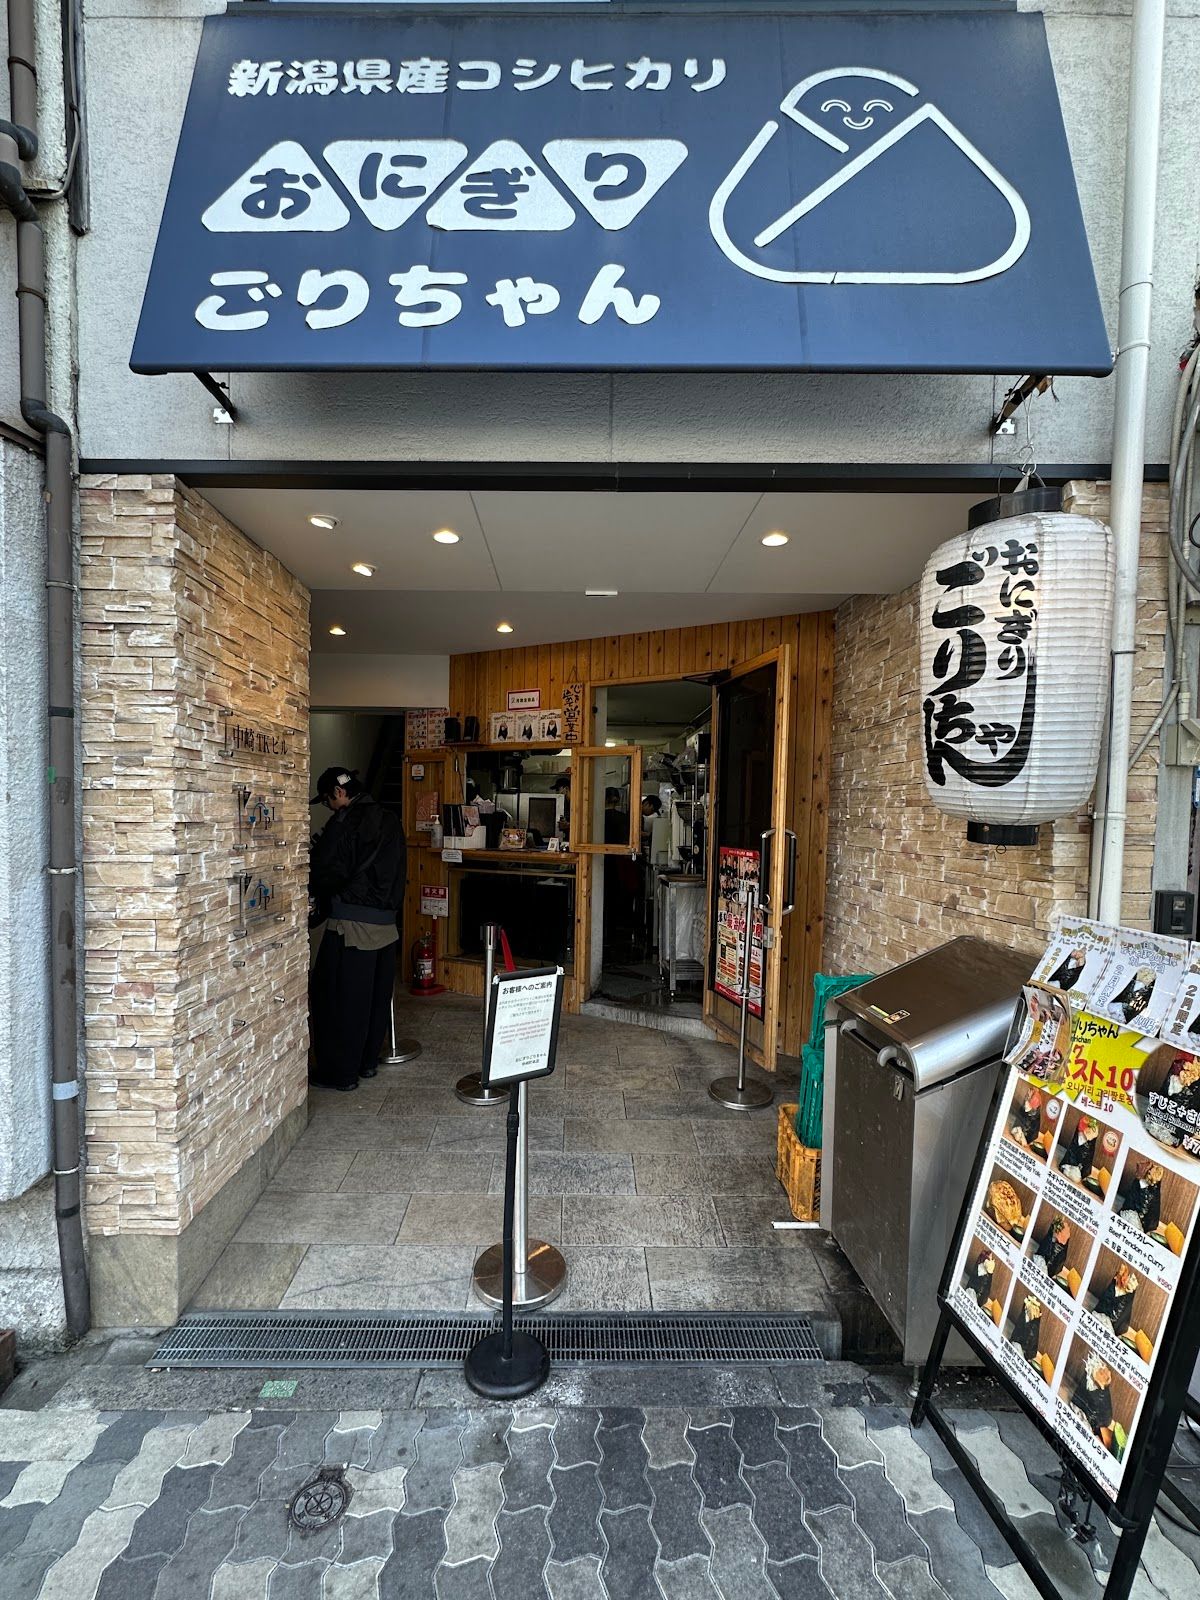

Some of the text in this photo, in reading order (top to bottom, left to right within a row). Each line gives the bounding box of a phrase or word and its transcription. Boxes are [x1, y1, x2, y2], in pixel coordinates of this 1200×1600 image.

[228, 56, 727, 97] 新潟県産コシヒカリ
[240, 149, 650, 223] おにぎり
[194, 263, 661, 332] ごりちゃん
[994, 539, 1040, 680] おにぎり
[923, 546, 1037, 787] ごりちゃん
[502, 981, 552, 995] お客様へのご案内
[1074, 1020, 1119, 1039] りちゃん
[1170, 984, 1199, 1036] 2月限定
[1103, 1103, 1113, 1113] 10
[1183, 1134, 1200, 1155] ¥7
[1061, 1189, 1072, 1200] Tuna
[1108, 1225, 1121, 1239] Beef
[1121, 1234, 1143, 1255] Tendon
[1147, 1253, 1165, 1272] Curry
[1105, 1342, 1119, 1358] Pork
[1119, 1354, 1130, 1368] and
[1130, 1365, 1147, 1385] Kimch
[1075, 1441, 1092, 1466] Boiled
